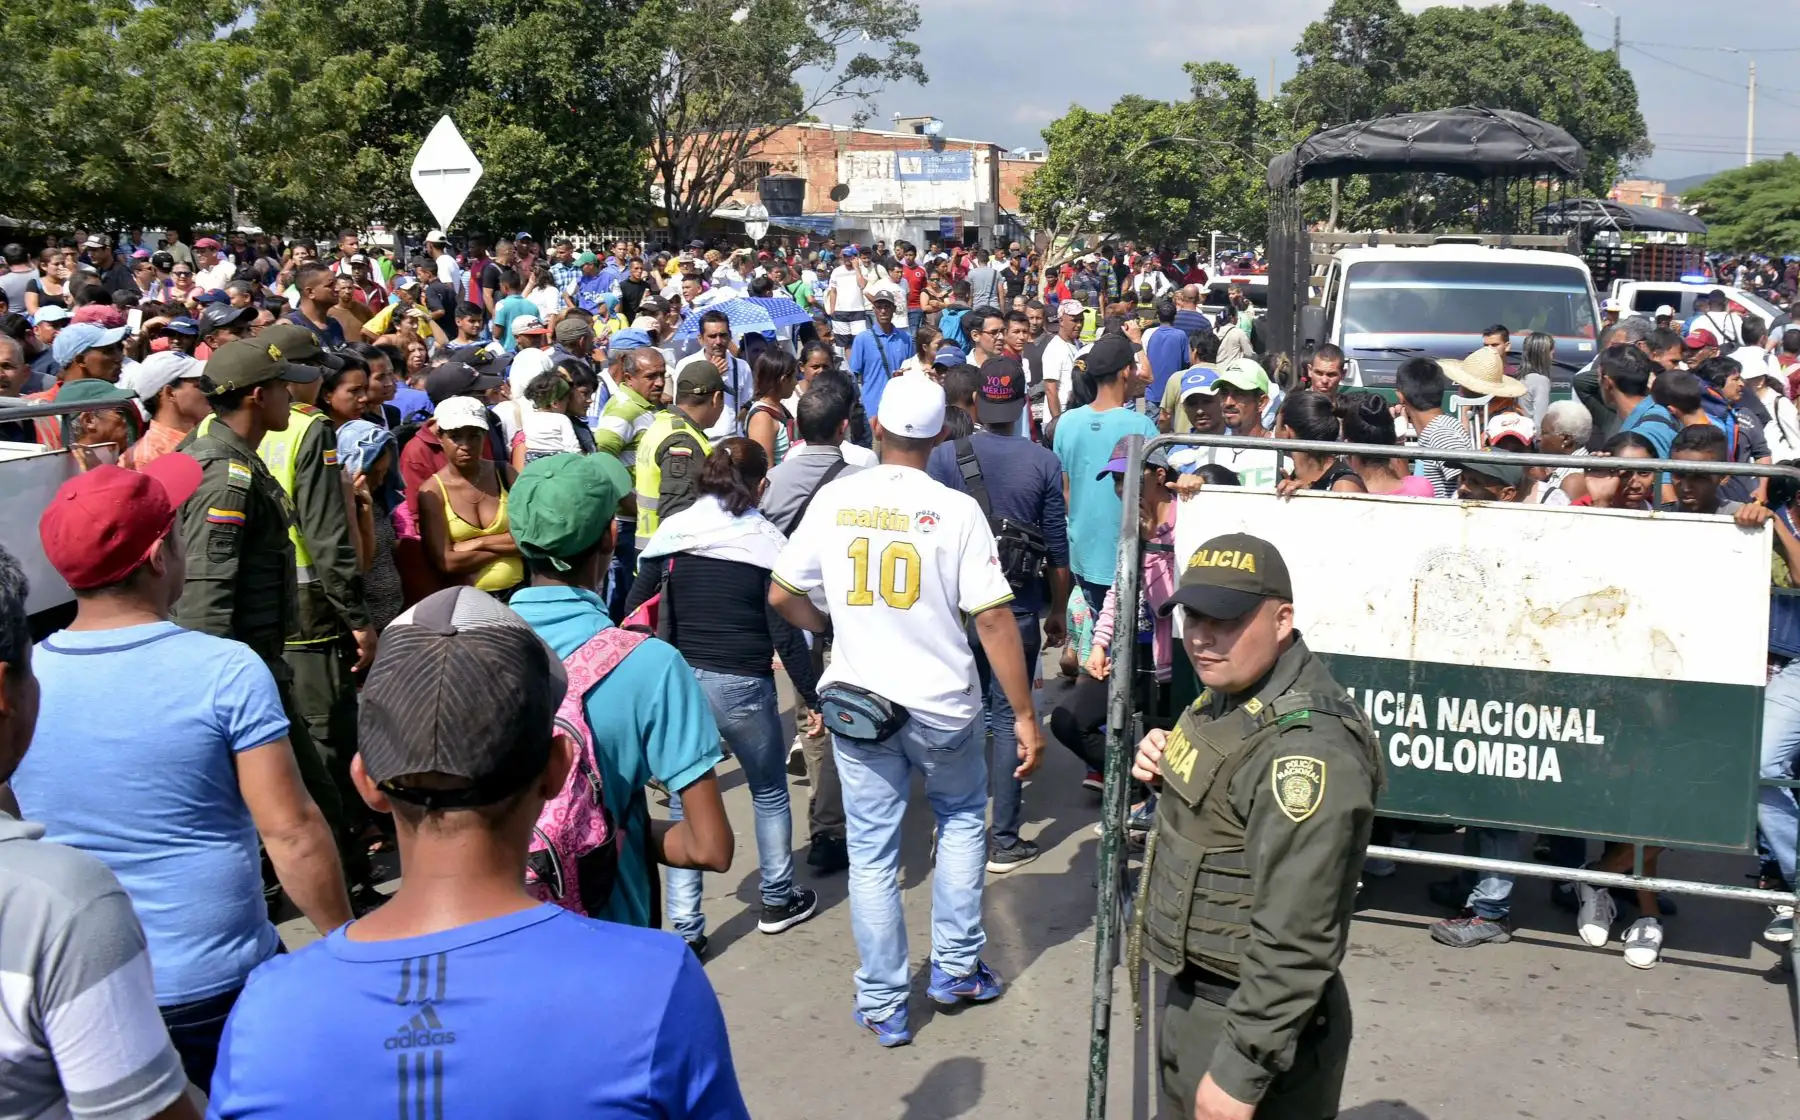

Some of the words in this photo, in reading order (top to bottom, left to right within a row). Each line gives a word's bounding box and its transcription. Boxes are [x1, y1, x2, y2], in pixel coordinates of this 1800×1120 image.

[986, 374, 1000, 386] YO
[847, 536, 921, 610] 10
[1188, 549, 1256, 573] OLICIA
[1347, 687, 1428, 729] ICIA
[1436, 697, 1605, 745] NACIONAL
[1164, 725, 1199, 784] ICIA
[1388, 732, 1562, 783] COLOMBIA
[1277, 767, 1320, 783] NACIONAL
[384, 1031, 456, 1050] adidas
